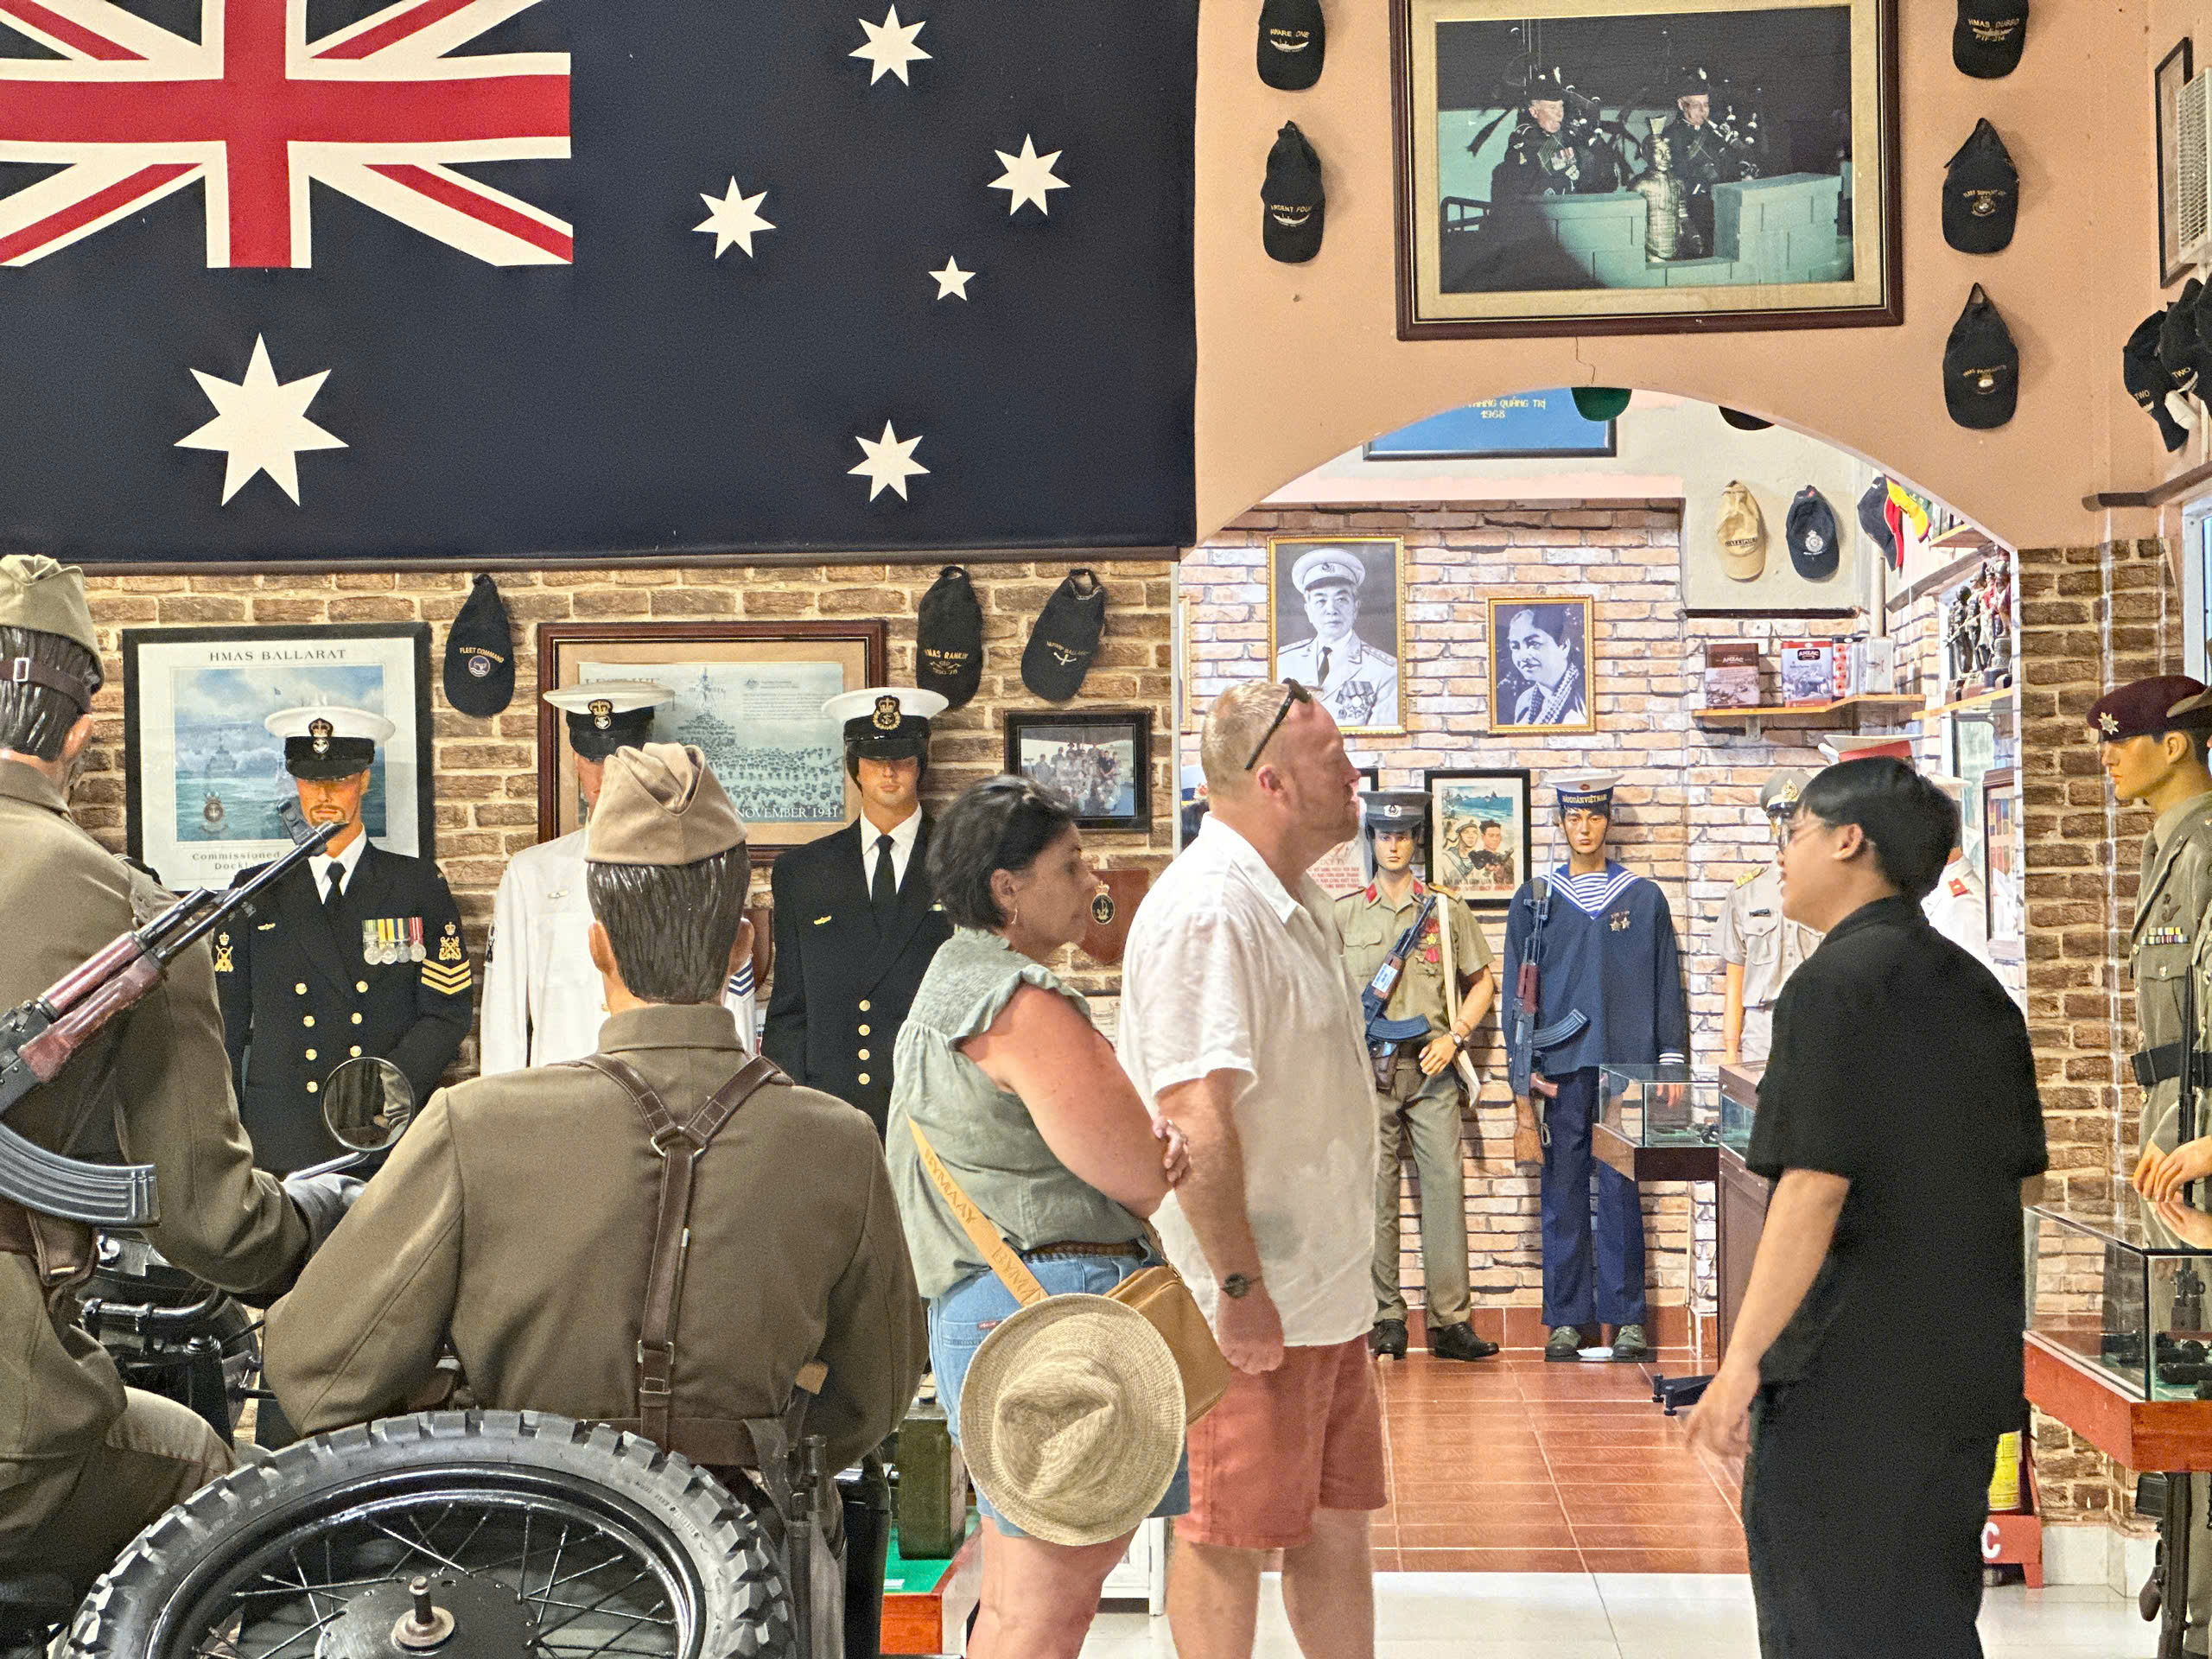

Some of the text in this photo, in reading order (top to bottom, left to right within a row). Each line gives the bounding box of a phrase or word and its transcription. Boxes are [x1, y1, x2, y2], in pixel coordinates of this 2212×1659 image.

[2172, 367, 2191, 379] TWO
[2134, 391, 2151, 400] TWO
[1480, 410, 1505, 419] 1968
[209, 649, 346, 662] HMAS BALLARAT
[476, 647, 505, 664] COMMAND
[735, 806, 838, 818] NOVEMBER 1941
[192, 851, 281, 861] Commissioned
[1980, 1522, 2001, 1559] C
